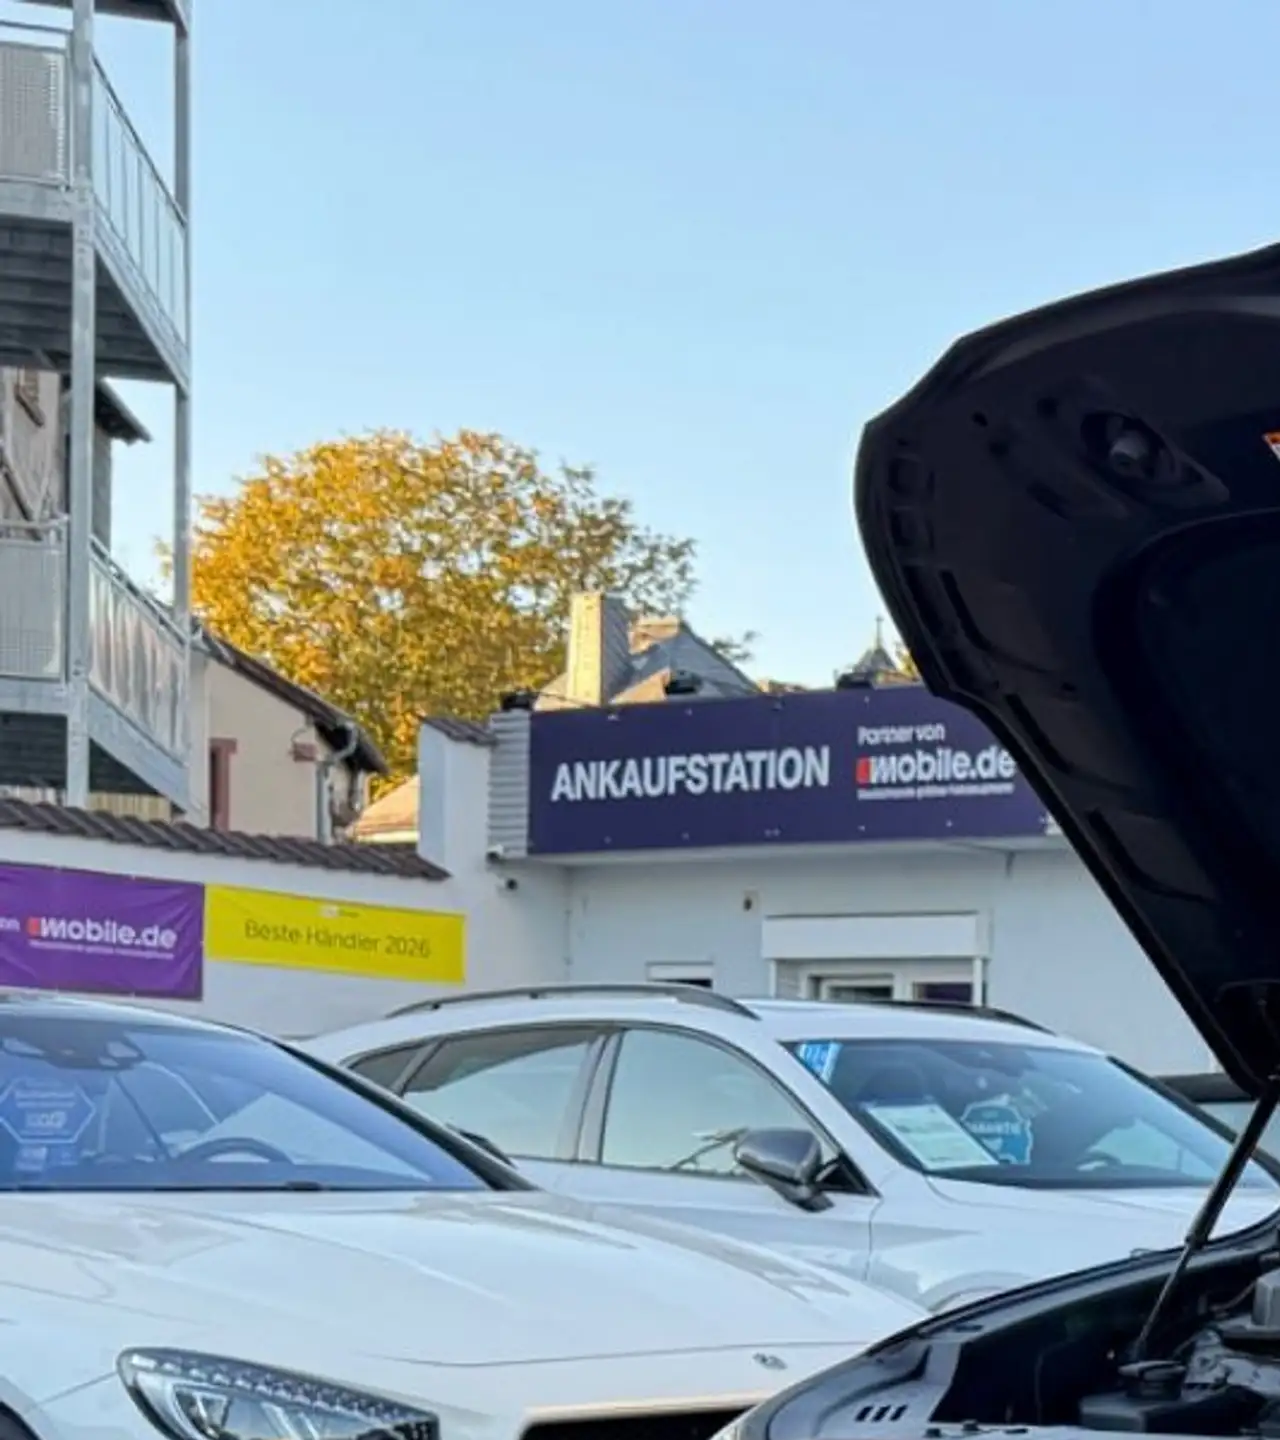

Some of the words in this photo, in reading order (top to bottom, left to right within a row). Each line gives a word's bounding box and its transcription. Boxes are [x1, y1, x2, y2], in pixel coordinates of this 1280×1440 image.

[551, 746, 830, 801] ANKAUFSTATION
[868, 745, 1016, 784] mobile.de
[38, 916, 178, 949] mobile.de
[244, 918, 302, 945] Beste
[306, 924, 381, 953] Händler
[385, 934, 431, 960] 2026
